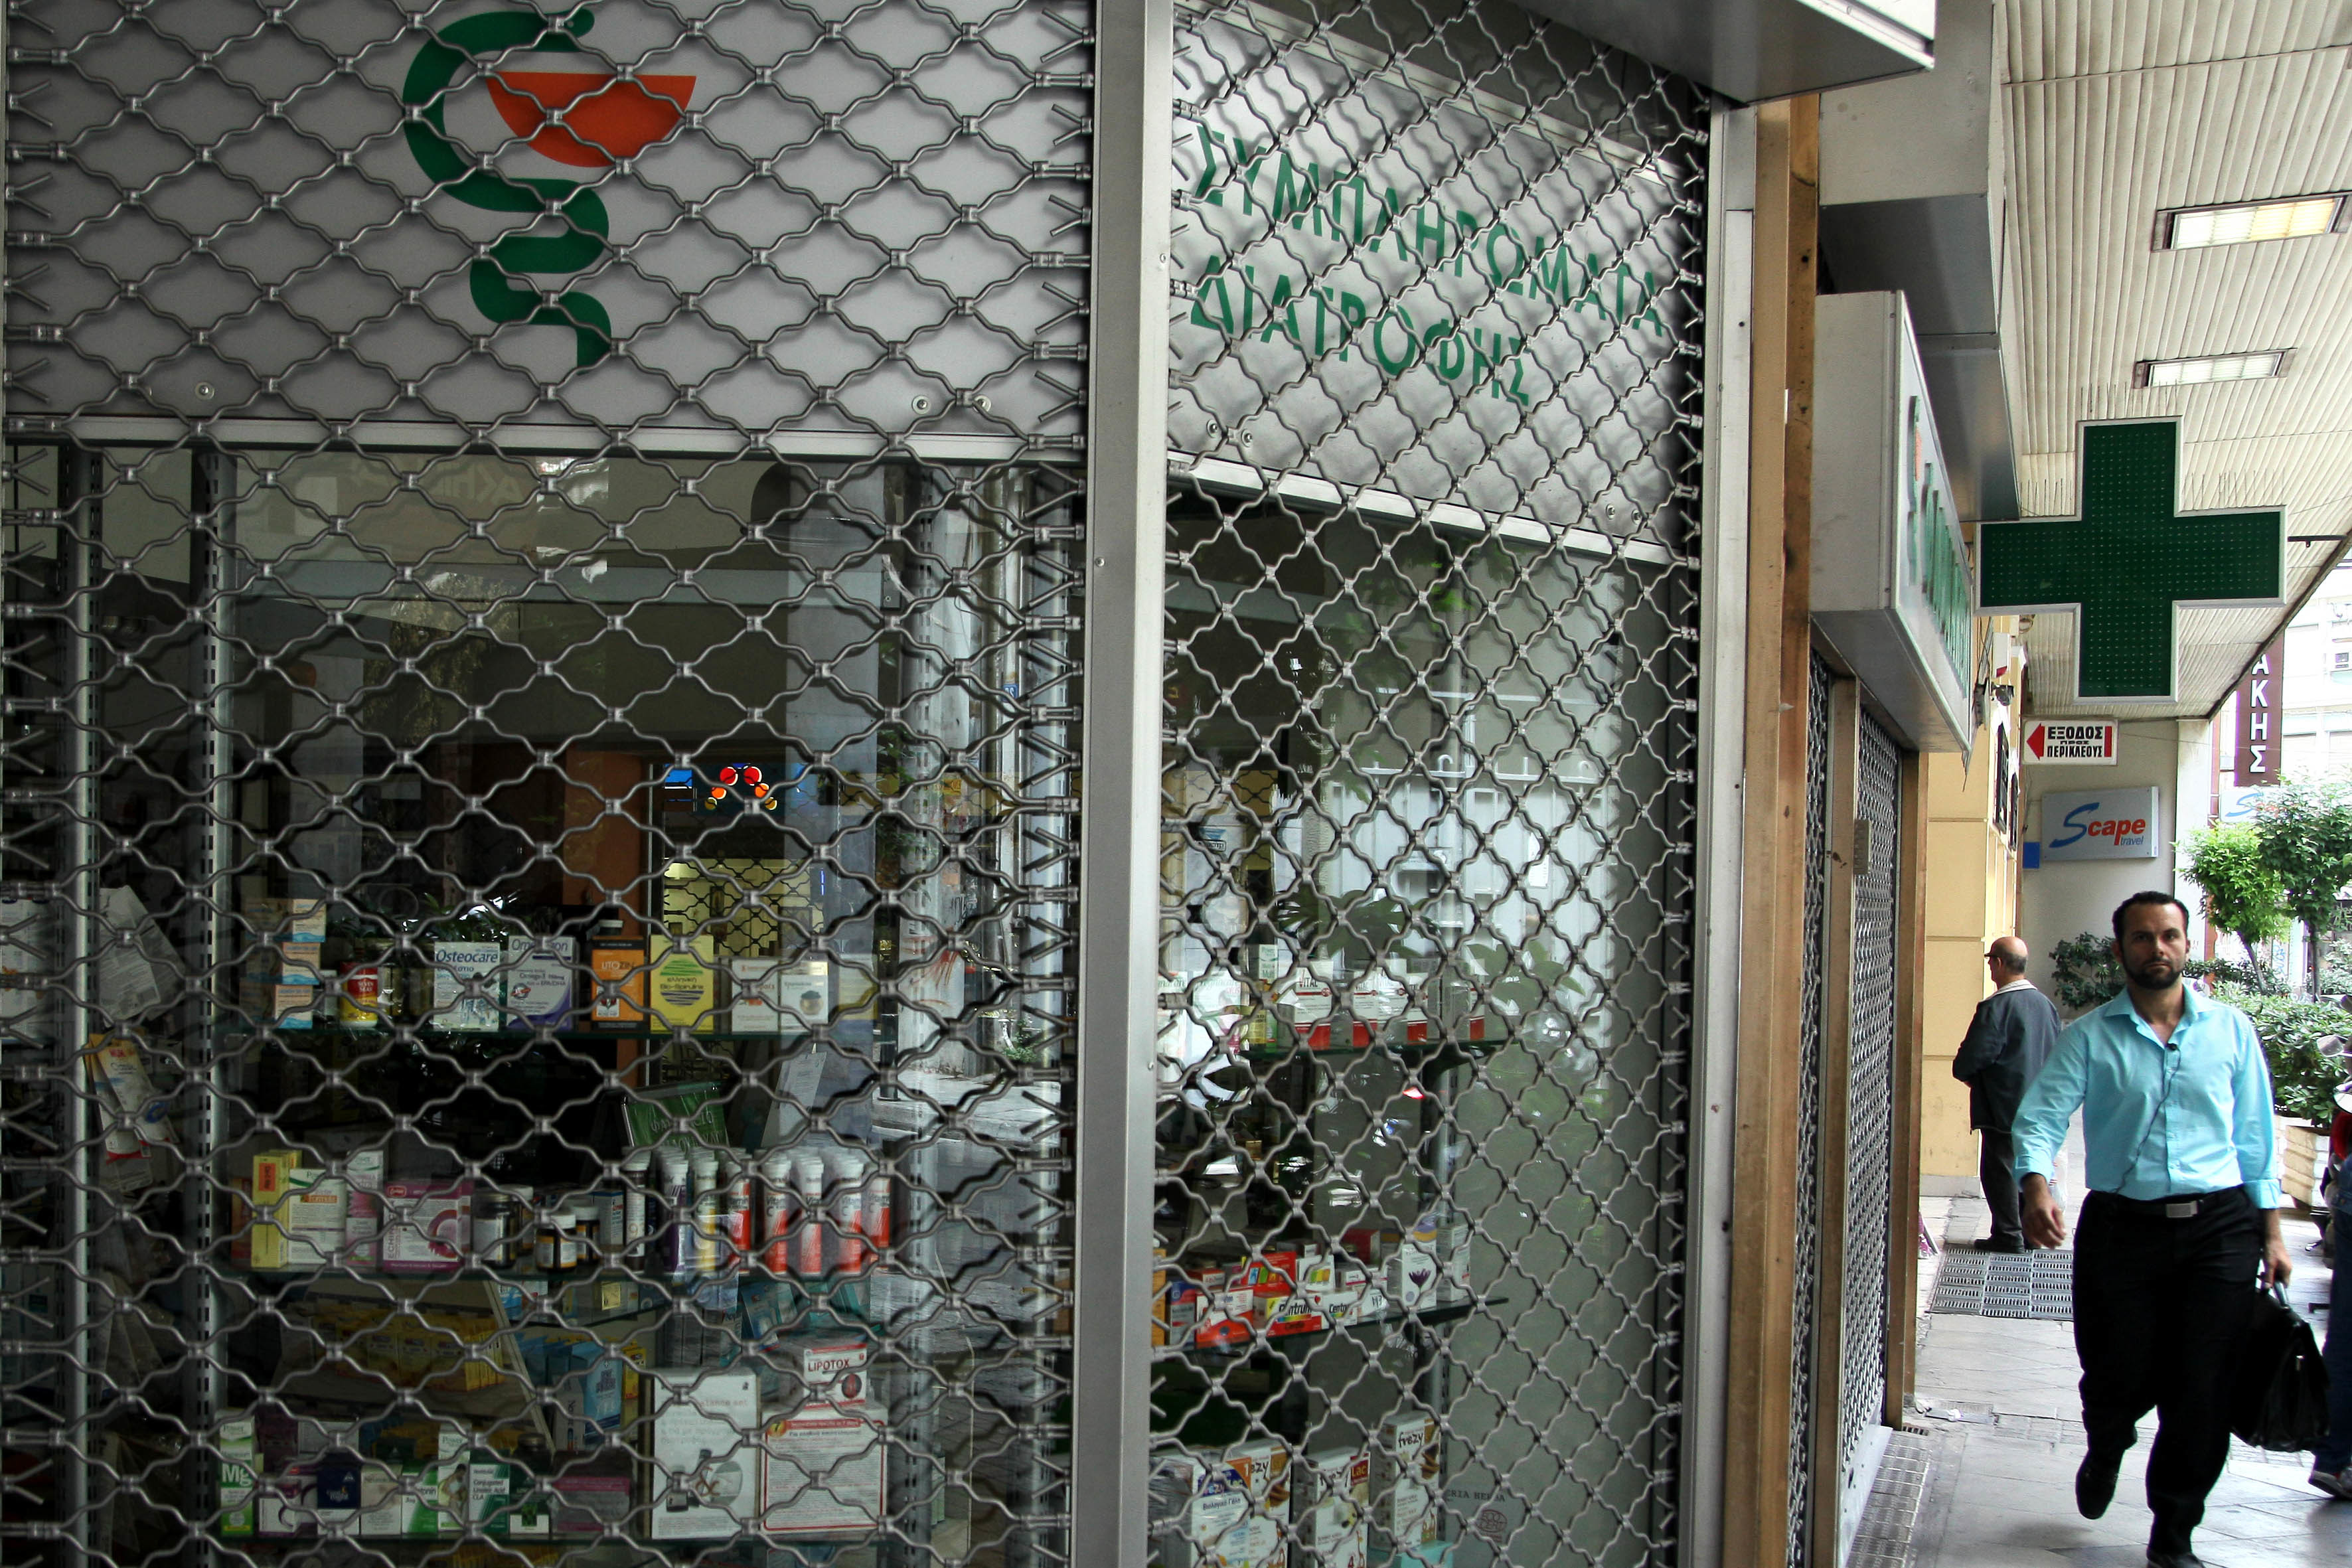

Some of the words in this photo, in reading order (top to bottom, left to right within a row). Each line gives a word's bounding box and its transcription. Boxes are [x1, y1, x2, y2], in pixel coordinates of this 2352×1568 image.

[1192, 255, 1528, 405] ΔΙΑΤΡΟΦΗΣ
[2047, 726, 2103, 740] ΕΞΟΔΟΣ
[2047, 745, 2102, 757] ΠΕΡΙΚΛΕΟΥΣ
[2048, 801, 2146, 848] Scape
[2120, 836, 2144, 846] travel
[435, 949, 498, 963] Osteocare
[808, 1359, 850, 1372] LIPOTOX
